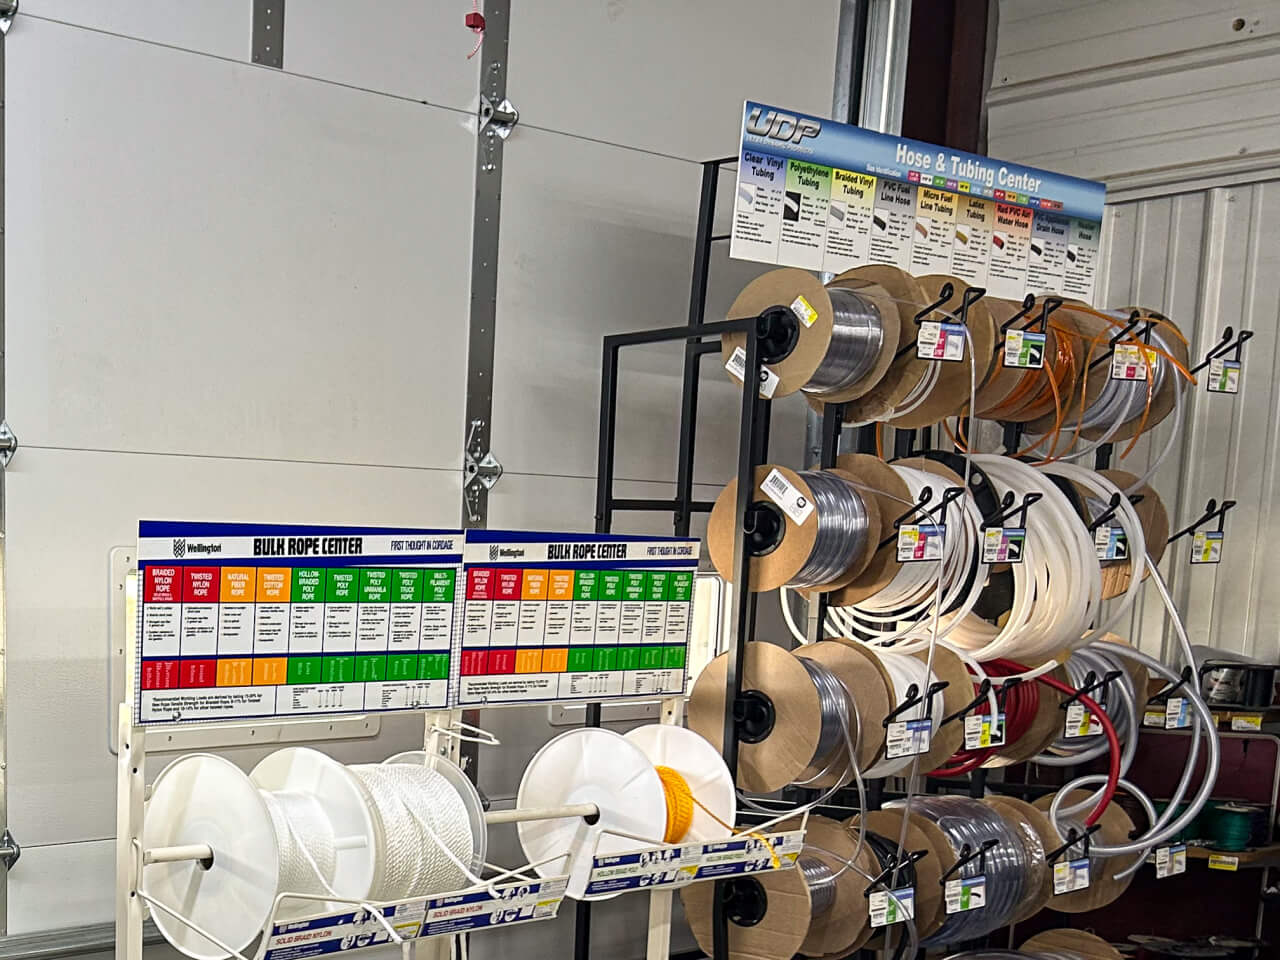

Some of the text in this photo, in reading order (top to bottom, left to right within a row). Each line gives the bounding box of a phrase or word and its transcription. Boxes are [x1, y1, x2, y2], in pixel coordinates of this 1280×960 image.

[746, 107, 821, 144] UDP
[745, 152, 784, 170] Clear Vinyl
[896, 143, 932, 169] Hose
[935, 152, 946, 172] &
[950, 155, 995, 188] Tubing
[998, 167, 1042, 193] Center
[752, 166, 775, 181] Tubing
[789, 161, 830, 178] Polyethylene
[797, 175, 820, 190] Tubing
[835, 171, 874, 188] Braided Vinyl
[842, 184, 865, 199] Tubing
[880, 192, 911, 206] Line Hose
[923, 189, 953, 203] Micro Fuel
[920, 200, 953, 217] Line Tubing
[966, 208, 985, 222] Tubing
[1015, 216, 1029, 228] Hose
[187, 537, 363, 556] Wellington BULK ROPE CENTER
[390, 540, 404, 551] FIRST
[547, 543, 627, 560] BULK ROPE CENTER
[154, 577, 173, 585] NYLON
[190, 572, 213, 581] TWISTED
[192, 580, 210, 588] NYLON
[275, 937, 292, 946] SOLID
[312, 930, 332, 940] NYLON
